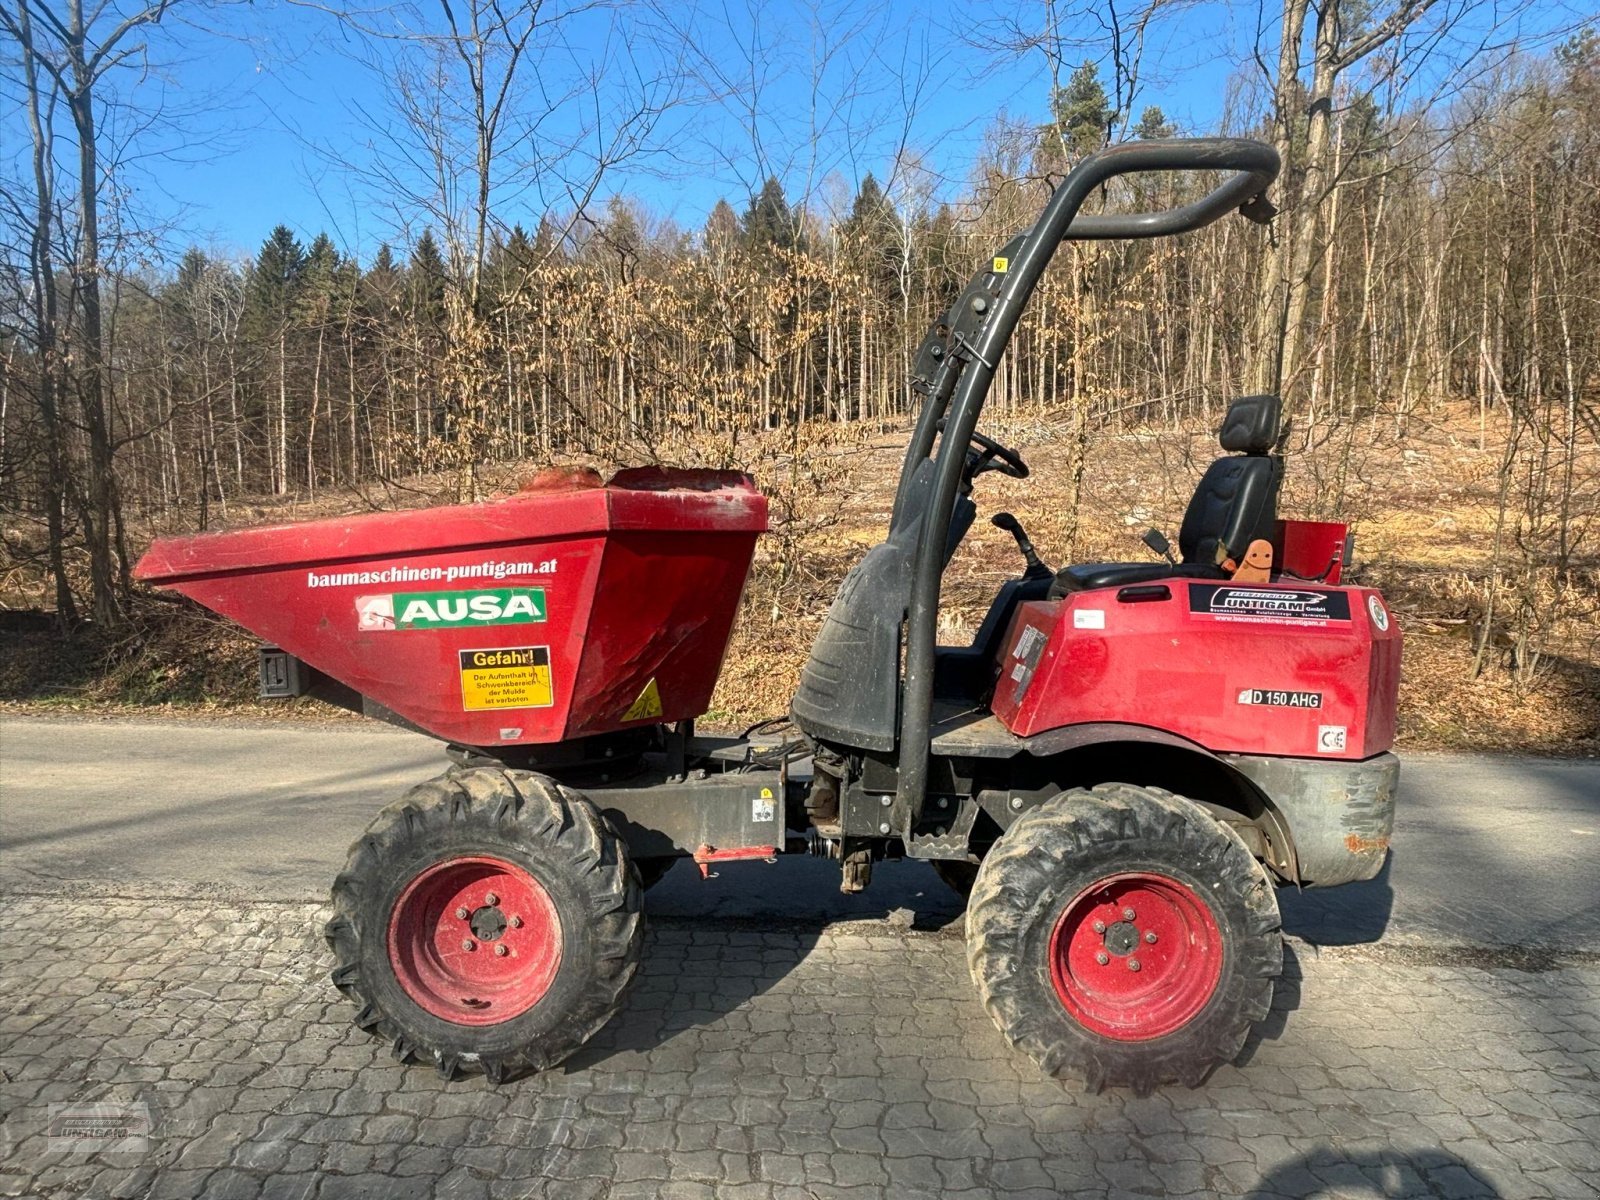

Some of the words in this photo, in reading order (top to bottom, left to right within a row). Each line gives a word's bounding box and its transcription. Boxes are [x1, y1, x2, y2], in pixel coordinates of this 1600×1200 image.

[307, 558, 558, 588] baumaschinen-puntigam.at
[400, 594, 542, 622] AUSA
[473, 649, 534, 666] Gefahr!
[476, 679, 537, 689] Schwenkbereich
[488, 672, 527, 680] Aufenthalt
[1253, 691, 1263, 703] D
[1266, 692, 1288, 705] 150
[1290, 693, 1319, 707] AHG
